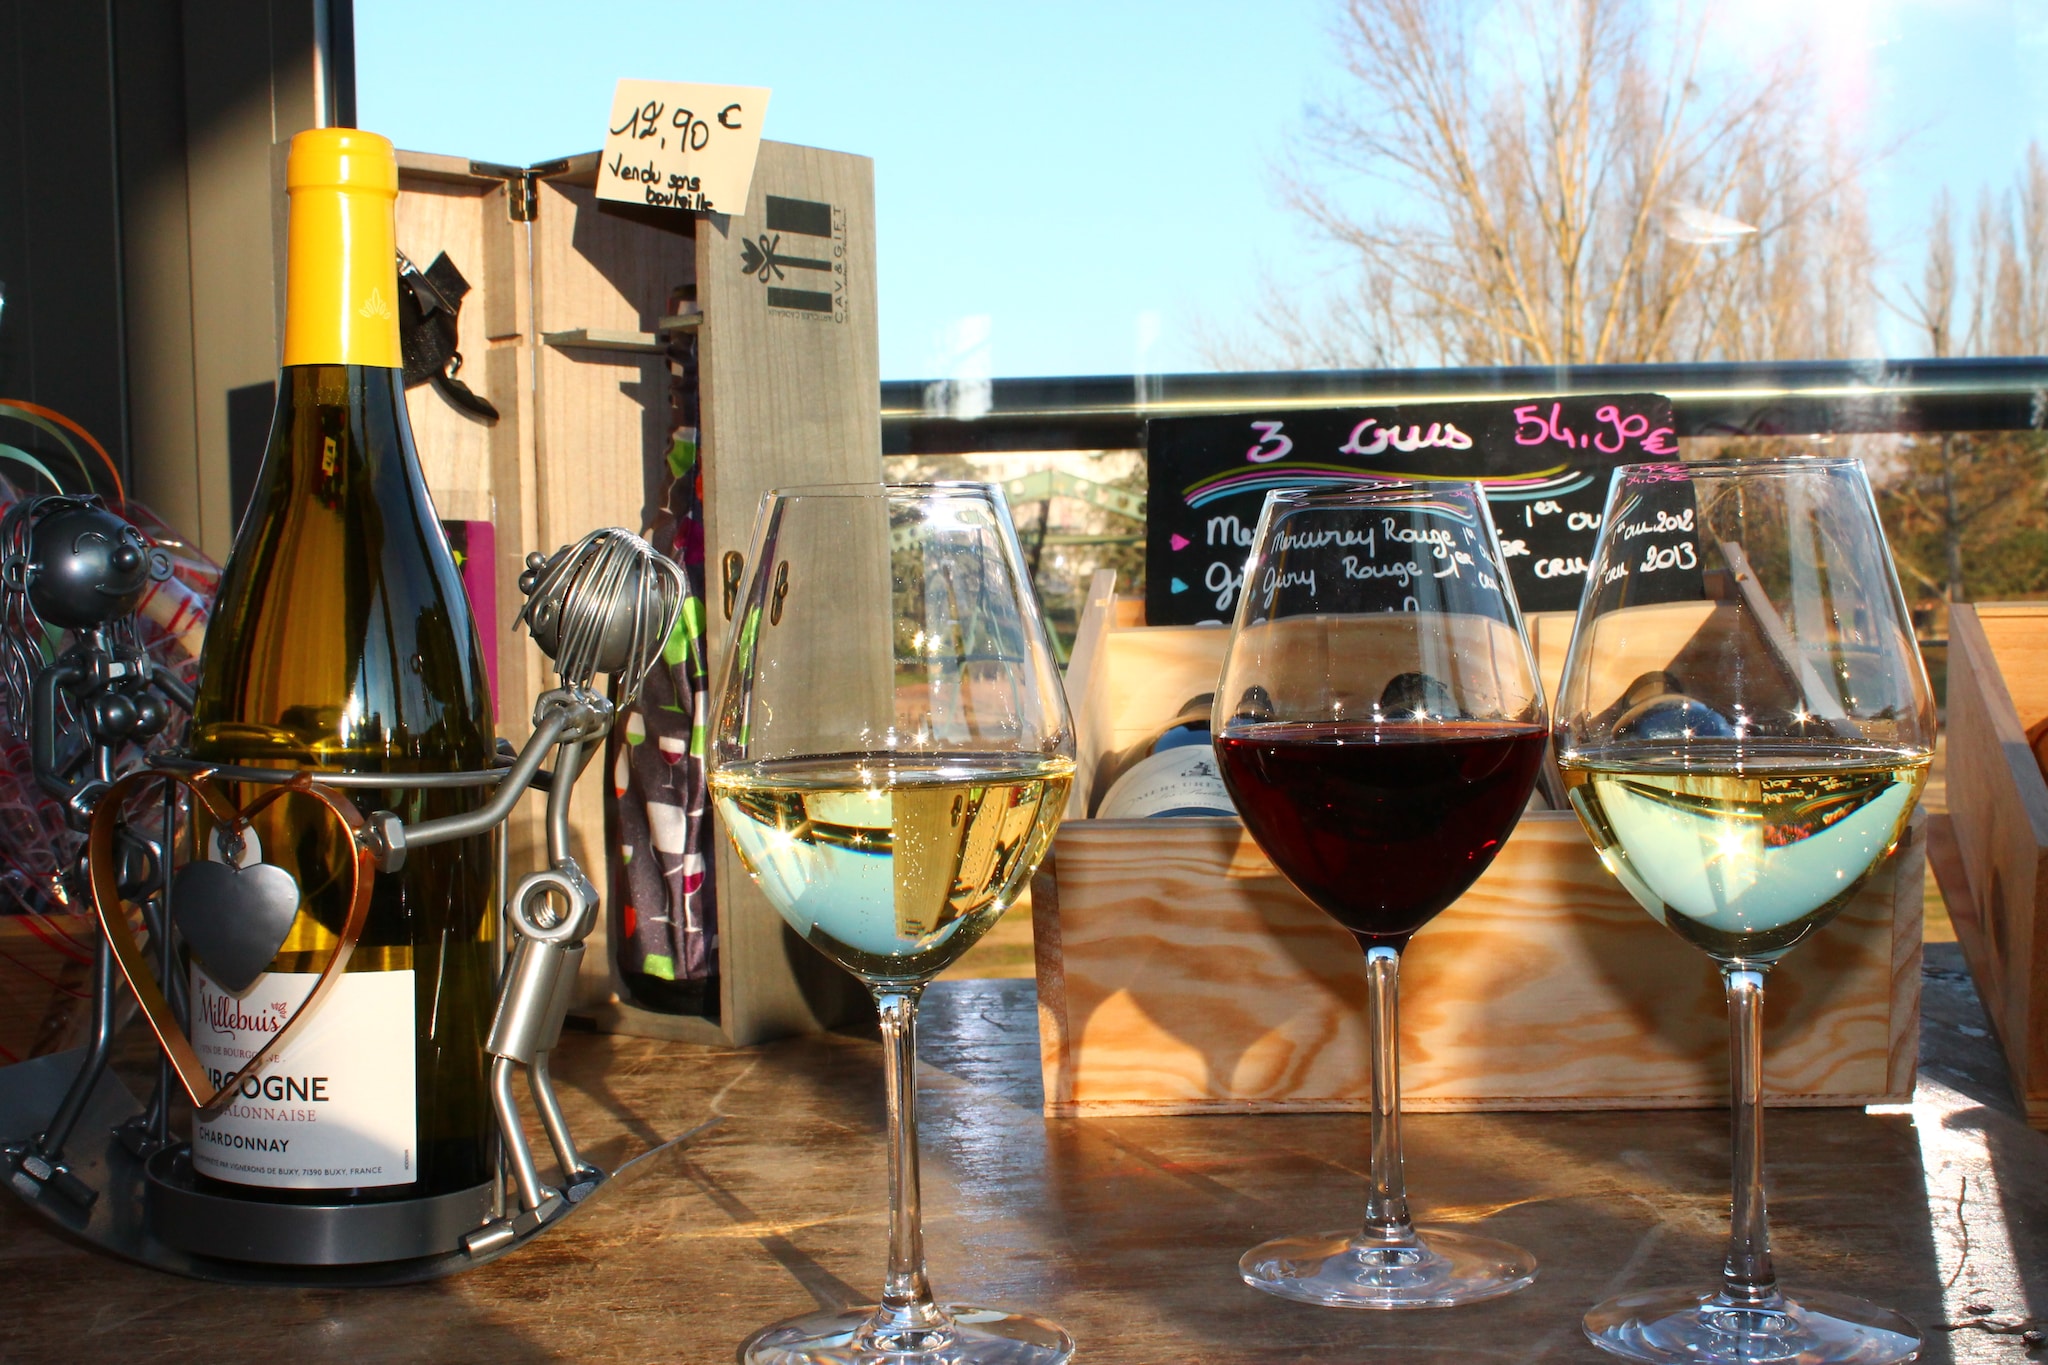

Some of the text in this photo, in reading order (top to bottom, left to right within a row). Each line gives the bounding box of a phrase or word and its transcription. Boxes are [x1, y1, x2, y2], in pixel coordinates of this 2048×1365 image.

[608, 152, 661, 184] Vendu
[1246, 420, 1293, 462] 3
[1382, 517, 1456, 559] Rouge
[1342, 555, 1423, 588] Rouge
[1640, 541, 1697, 573] 2013
[199, 992, 281, 1041] Millebuis
[199, 1126, 289, 1153] CHARDONNAY
[230, 1162, 266, 1174] VIGNERONS
[266, 1166, 277, 1175] DE
[350, 1166, 383, 1175] FRANCE
